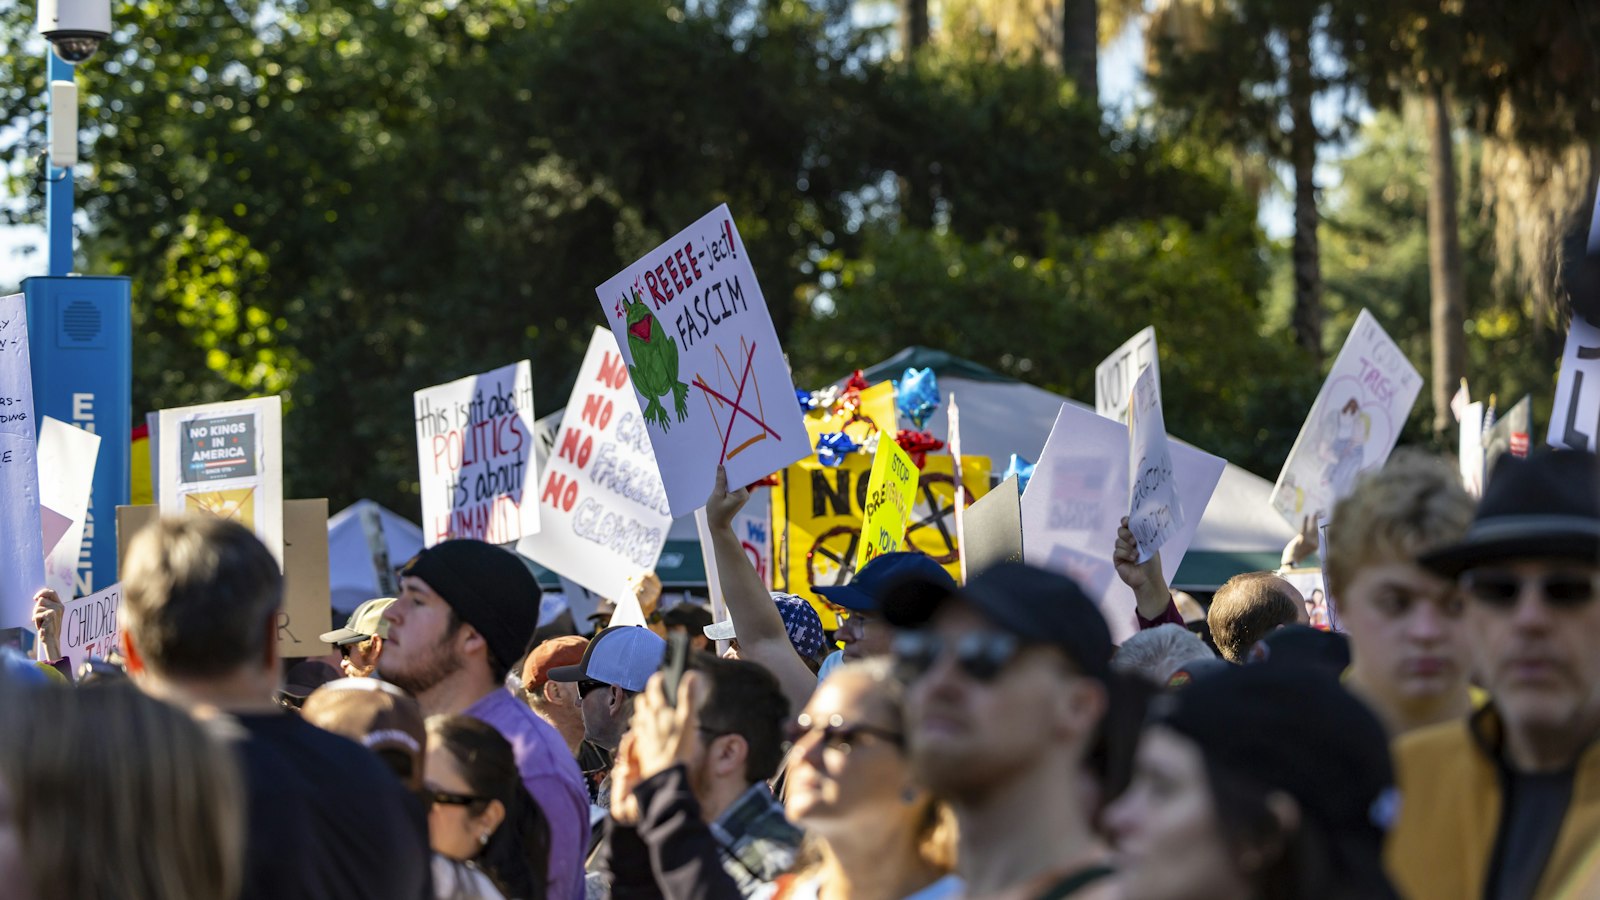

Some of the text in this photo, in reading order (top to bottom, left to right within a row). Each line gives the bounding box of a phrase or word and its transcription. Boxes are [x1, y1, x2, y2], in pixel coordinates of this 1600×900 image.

[644, 219, 737, 311] REEEE-ject!
[676, 274, 748, 352] FASCIM
[595, 351, 628, 390] NO
[415, 396, 449, 438] this
[487, 374, 532, 419] about
[582, 394, 613, 431] NO
[189, 422, 247, 439] NO KINGS
[211, 436, 225, 448] IN
[432, 412, 523, 475] POLITICS
[558, 427, 593, 470] NO
[191, 446, 245, 462] AMERICA
[891, 453, 910, 485] STOP
[476, 450, 525, 502] about
[541, 470, 578, 513] NO
[435, 488, 524, 545] HUMANITY
